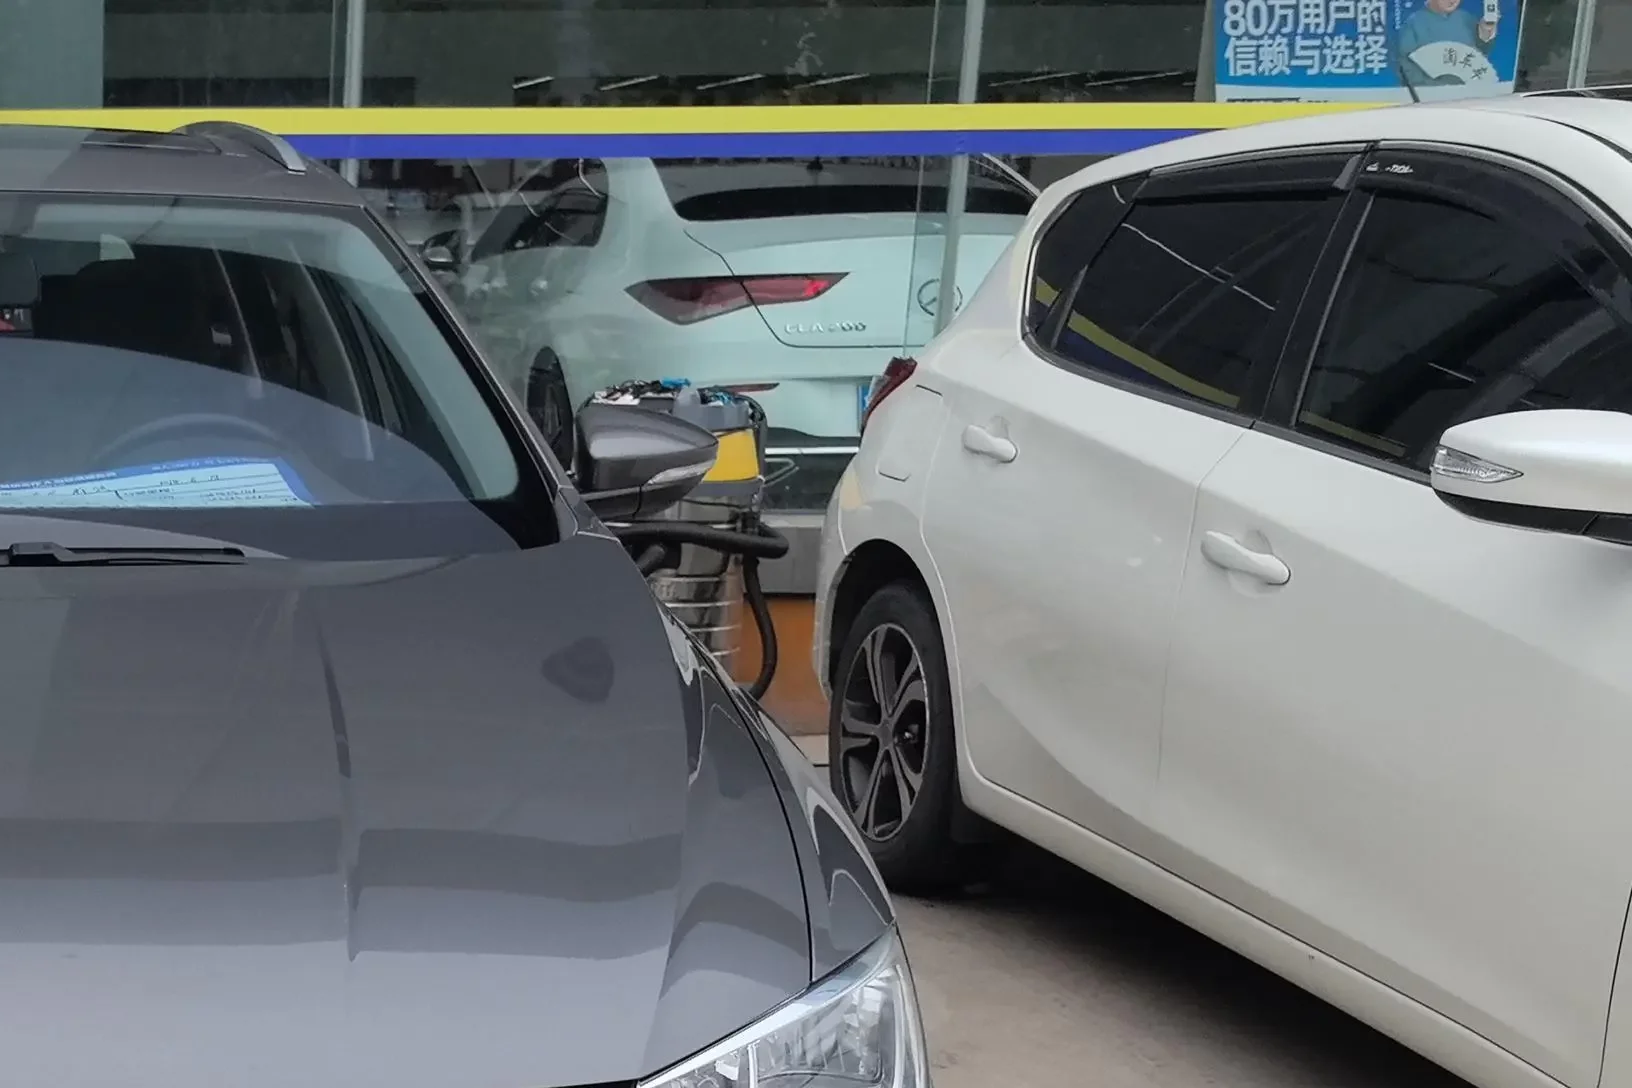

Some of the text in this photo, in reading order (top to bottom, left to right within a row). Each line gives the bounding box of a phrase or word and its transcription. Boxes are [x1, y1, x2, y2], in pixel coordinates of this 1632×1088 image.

[1223, 0, 1386, 36] 80万用户的
[1224, 34, 1388, 76] 信赖与选择
